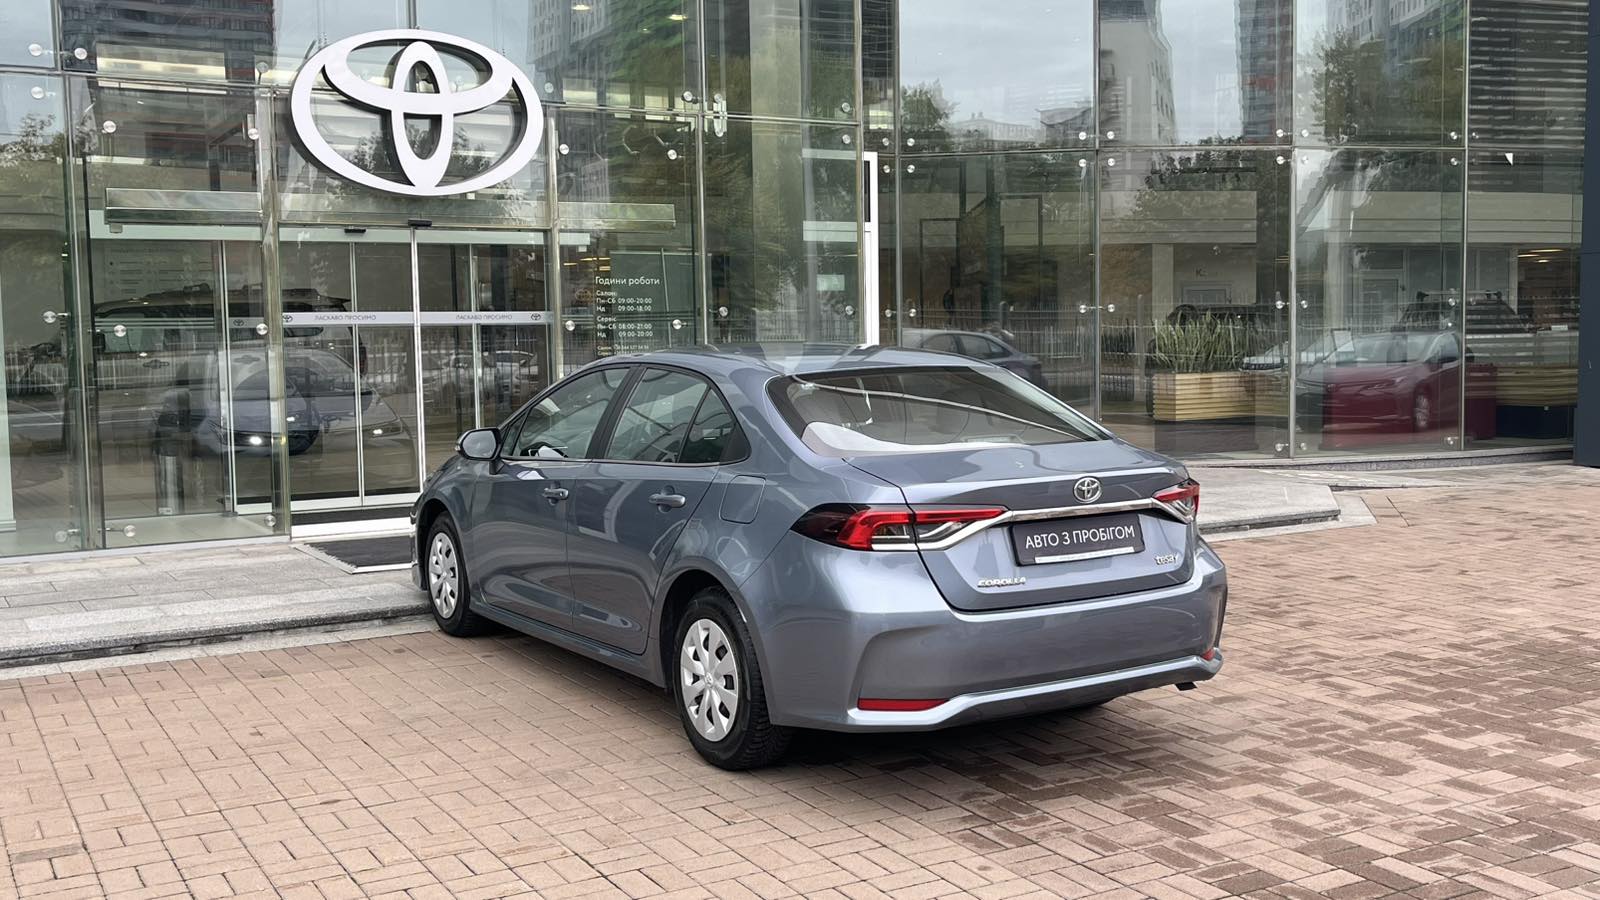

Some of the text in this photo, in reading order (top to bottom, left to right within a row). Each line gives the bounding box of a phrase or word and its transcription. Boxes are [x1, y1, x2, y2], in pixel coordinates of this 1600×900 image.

[595, 276, 660, 287] Години роботи
[1025, 532, 1060, 549] АВТО
[1072, 524, 1136, 544] ПРОБІГОМ
[978, 576, 1026, 588] COROLLA
